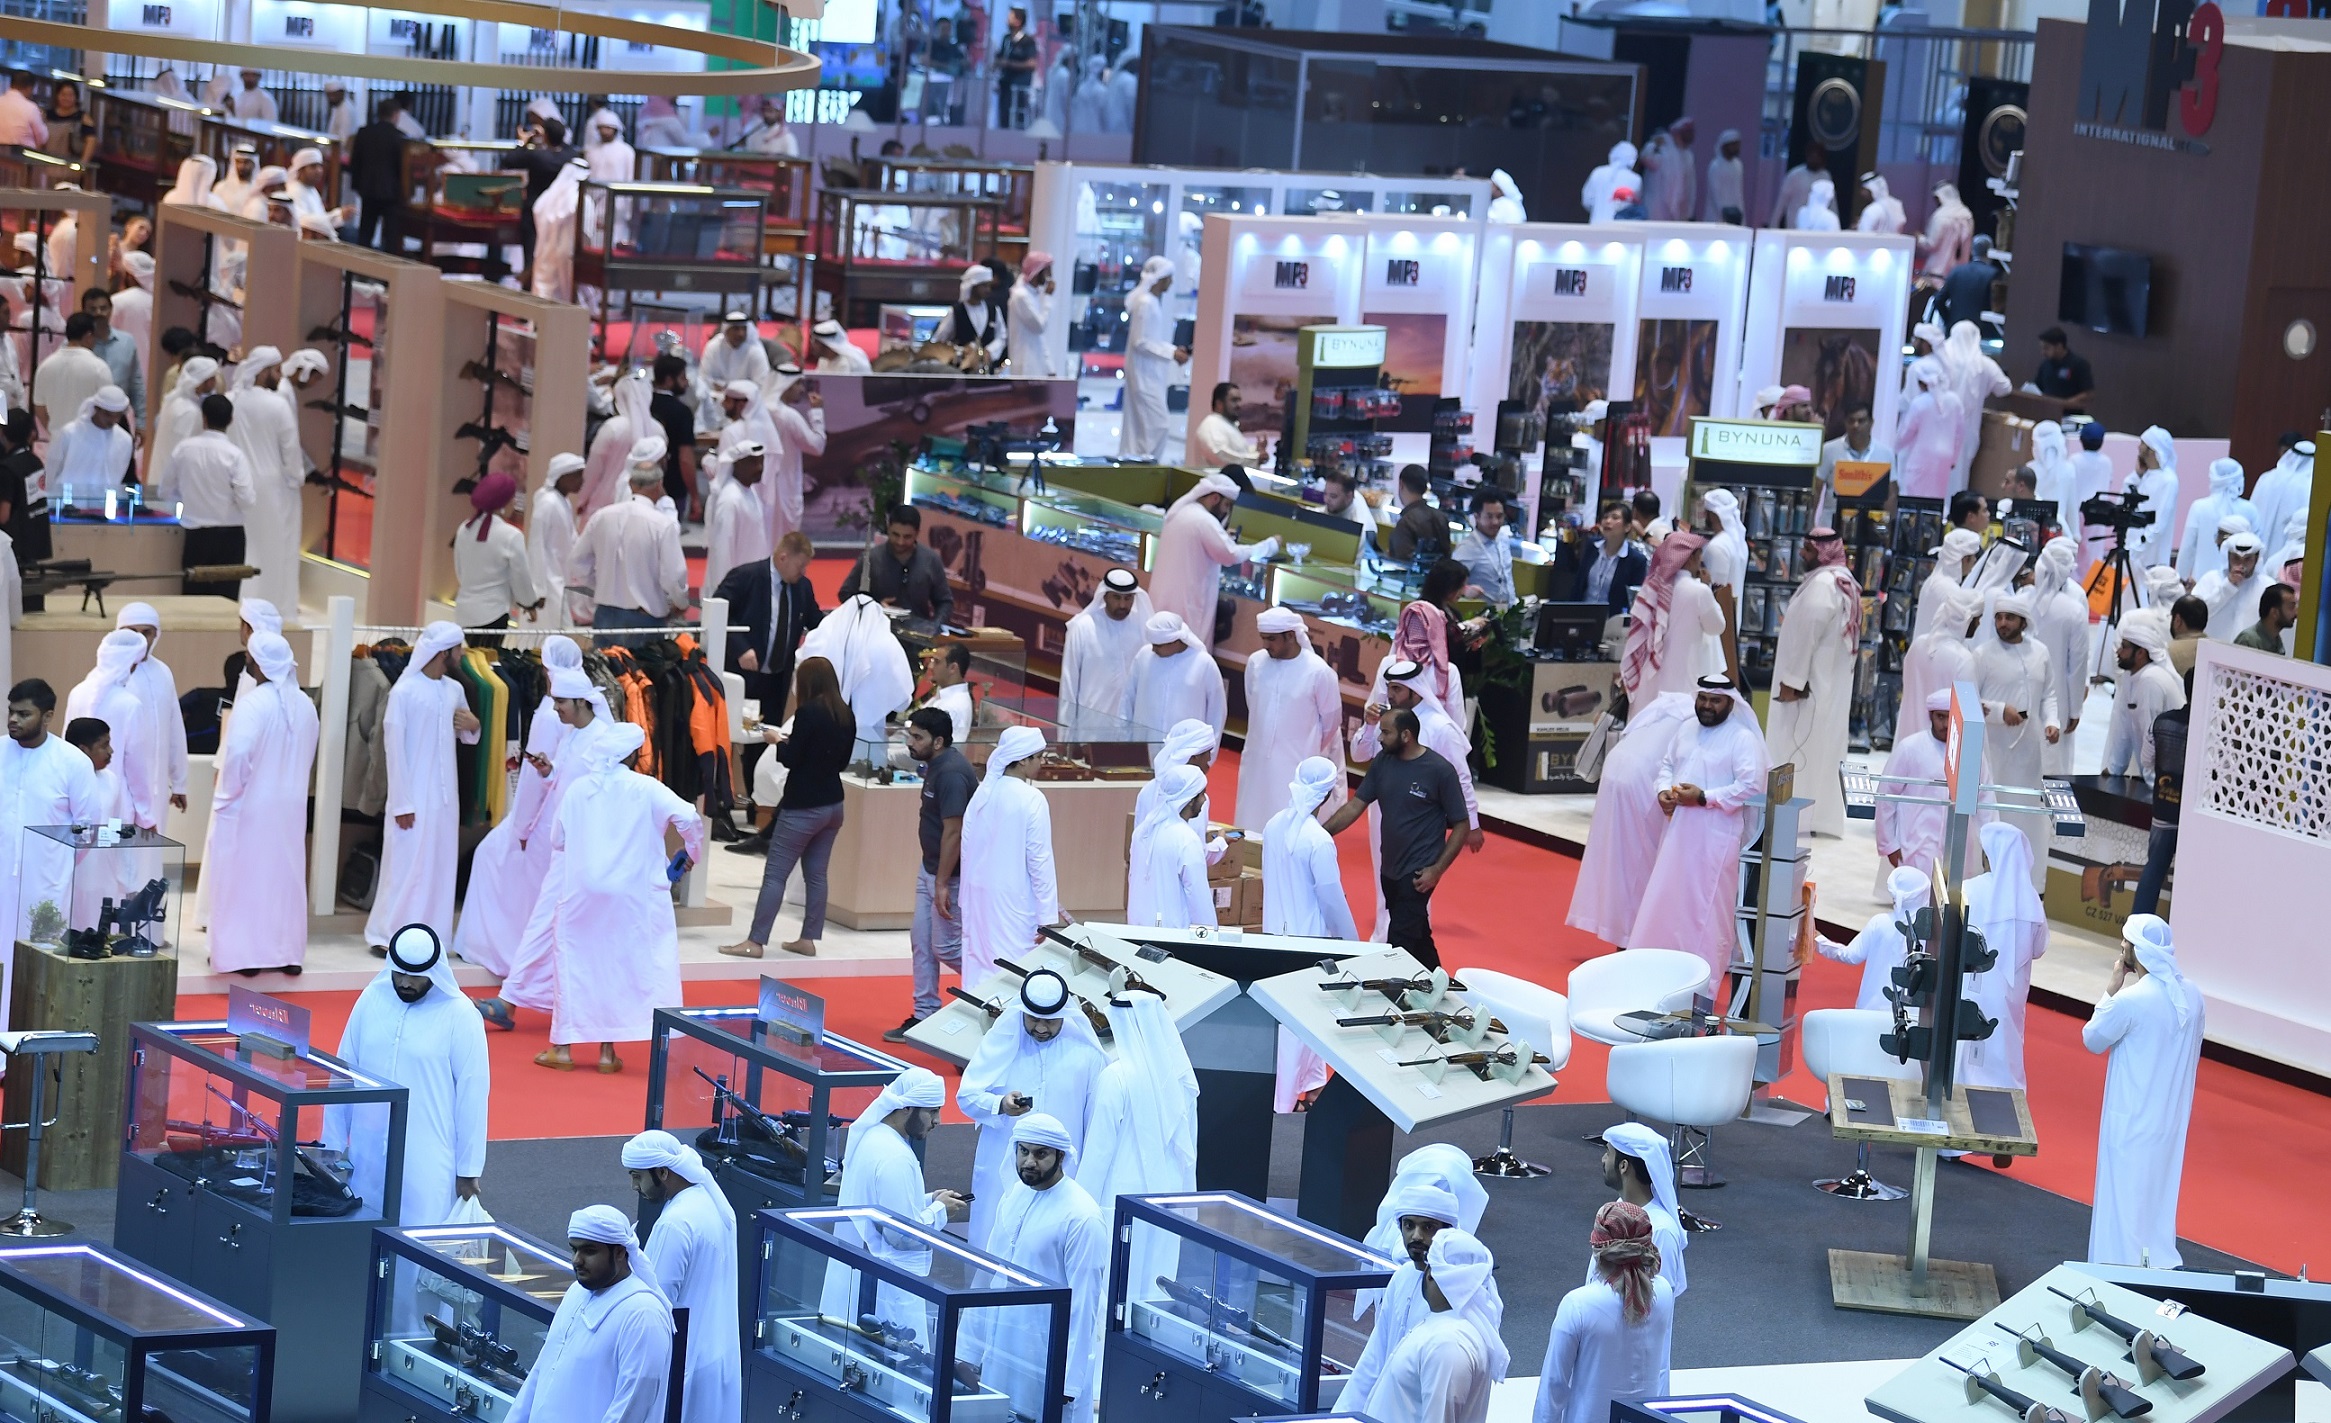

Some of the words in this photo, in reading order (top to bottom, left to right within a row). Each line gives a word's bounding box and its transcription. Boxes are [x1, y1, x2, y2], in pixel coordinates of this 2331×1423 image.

[2073, 121, 2176, 151] INTERNATIONAL
[1275, 261, 1309, 287] MP3
[1386, 259, 1419, 285] MP3
[1554, 269, 1588, 295] MP3
[1660, 267, 1693, 292] MP3
[1824, 275, 1856, 301] MP3
[1718, 430, 1801, 447] BYNUNA
[2086, 906, 2097, 918] CZ
